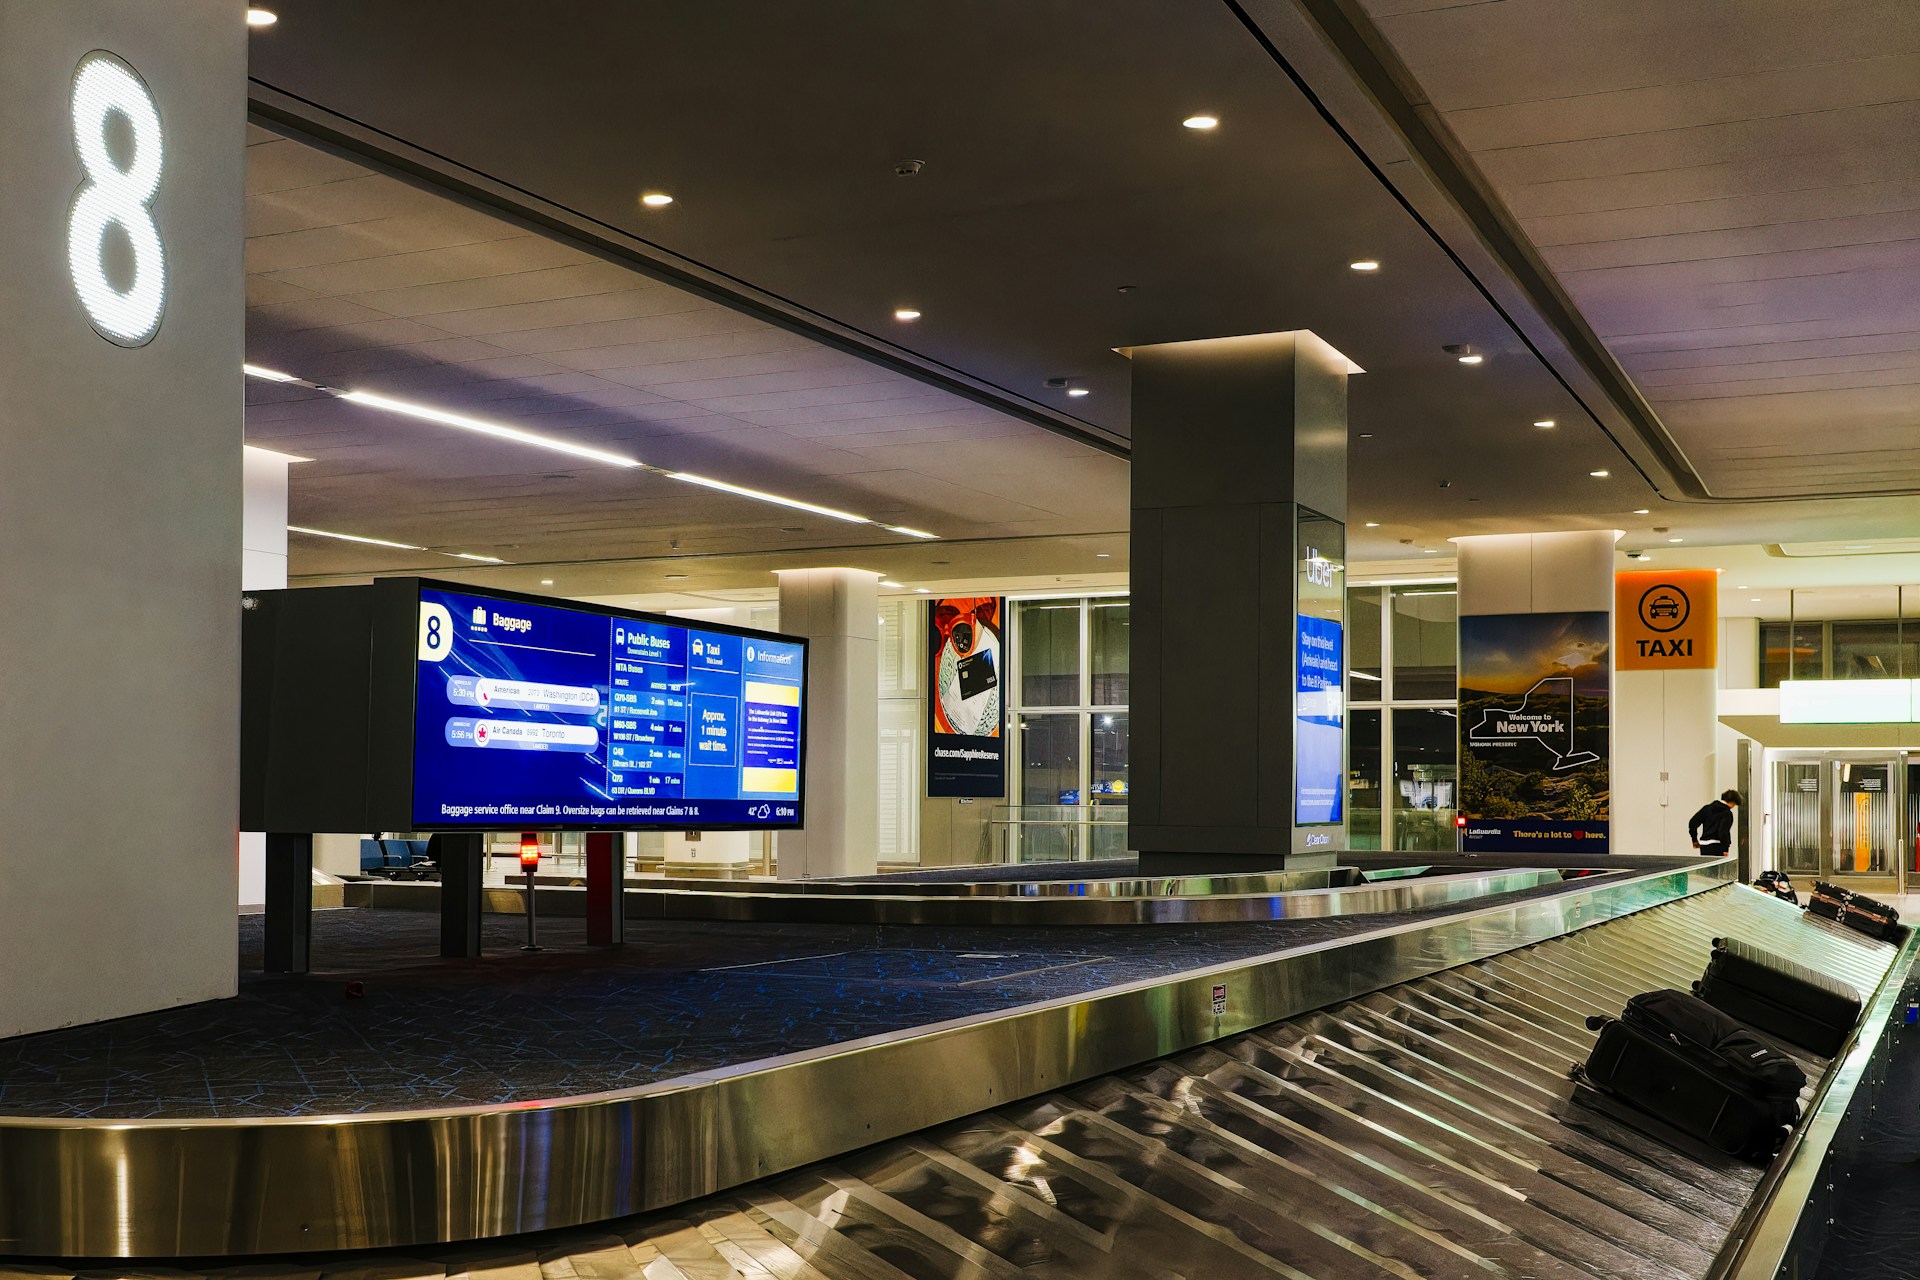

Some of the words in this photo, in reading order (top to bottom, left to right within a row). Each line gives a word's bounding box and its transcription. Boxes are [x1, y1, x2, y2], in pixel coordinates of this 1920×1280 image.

[68, 55, 167, 345] 8
[1306, 546, 1333, 589] Uber
[493, 613, 532, 633] Baggage
[427, 616, 440, 649] 8
[628, 633, 649, 647] Public
[650, 637, 670, 650] Buses
[1302, 632, 1311, 649] Stay
[707, 644, 721, 656] Taxi
[1636, 639, 1692, 657] TAXI
[757, 651, 792, 666] Information
[615, 663, 627, 672] MTA
[627, 664, 643, 674] Buses
[453, 688, 466, 698] 5:30
[466, 691, 475, 699] PM
[494, 685, 520, 695] American
[543, 689, 577, 702] Washington
[702, 708, 726, 723] Approx.
[502, 727, 523, 736] Canada
[543, 729, 565, 739] Toronto
[701, 726, 705, 736] 1
[706, 726, 727, 738] minute
[1497, 721, 1528, 733] New
[1530, 720, 1564, 733] York
[699, 740, 713, 751] wait
[714, 741, 727, 752] time.
[935, 747, 999, 761] chase.com/SapphireReserve
[441, 804, 473, 817] Baggage
[474, 804, 499, 815] service
[500, 804, 519, 815] office
[520, 806, 535, 815] near
[536, 805, 554, 815] Claim
[555, 805, 561, 815] 9.
[563, 805, 590, 815] Oversize
[591, 805, 605, 817] bags
[606, 807, 616, 815] can
[618, 805, 625, 815] be
[626, 806, 652, 815] retrieved
[653, 807, 665, 815] near
[666, 806, 683, 815] Claims
[684, 807, 688, 815] 7
[689, 807, 693, 815] &
[694, 807, 699, 815] 8.
[748, 807, 757, 816] 42°
[1585, 831, 1606, 839] here.
